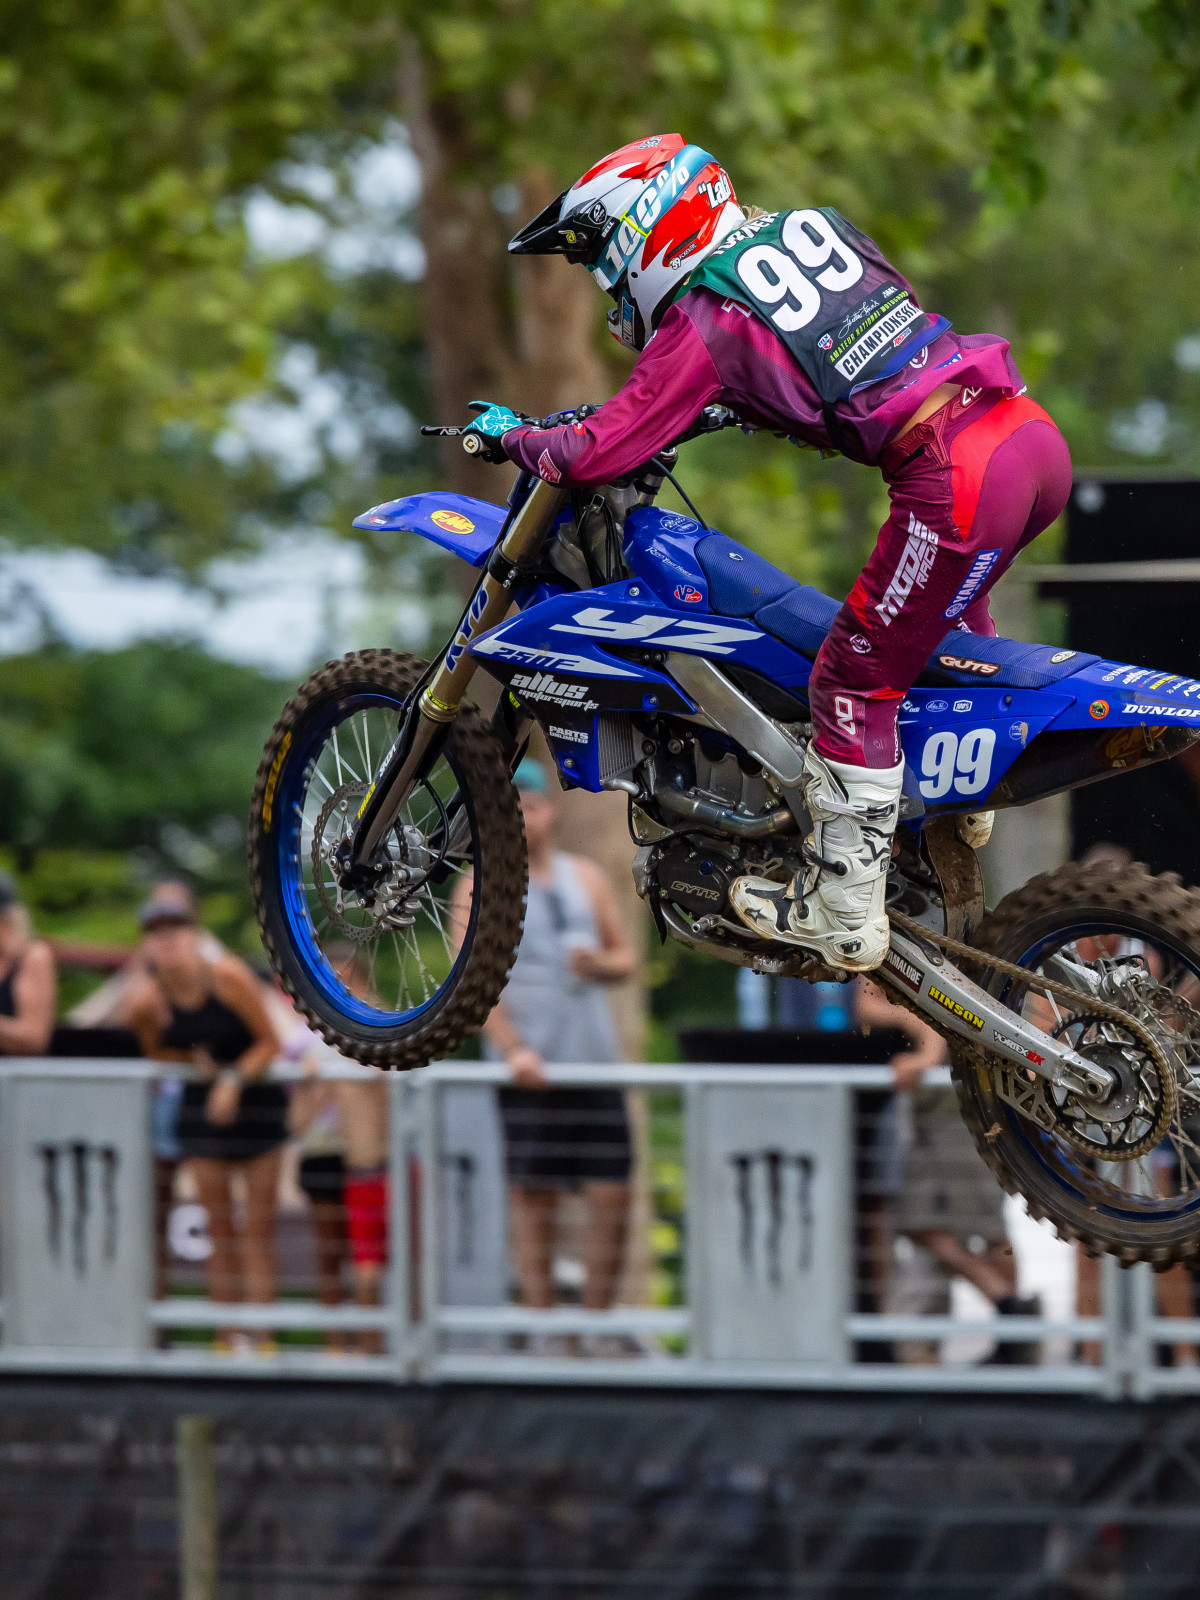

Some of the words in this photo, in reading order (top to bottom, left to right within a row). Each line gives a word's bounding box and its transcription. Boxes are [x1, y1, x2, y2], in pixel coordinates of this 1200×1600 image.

[606, 157, 690, 274] 100%
[735, 207, 867, 333] 99
[829, 332, 856, 363] AMATEUR
[440, 428, 465, 436] ASV
[435, 511, 476, 534] FMF
[953, 551, 996, 604] YAMAHA
[549, 607, 766, 655] YZ
[939, 656, 999, 674] GUTS
[509, 671, 590, 700] altus
[518, 688, 600, 711] motorsports
[549, 725, 589, 740] PARTS
[549, 732, 589, 744] UNLIMITED
[919, 728, 997, 799] 99
[670, 880, 721, 901] GYTR
[929, 985, 986, 1030] HINSON
